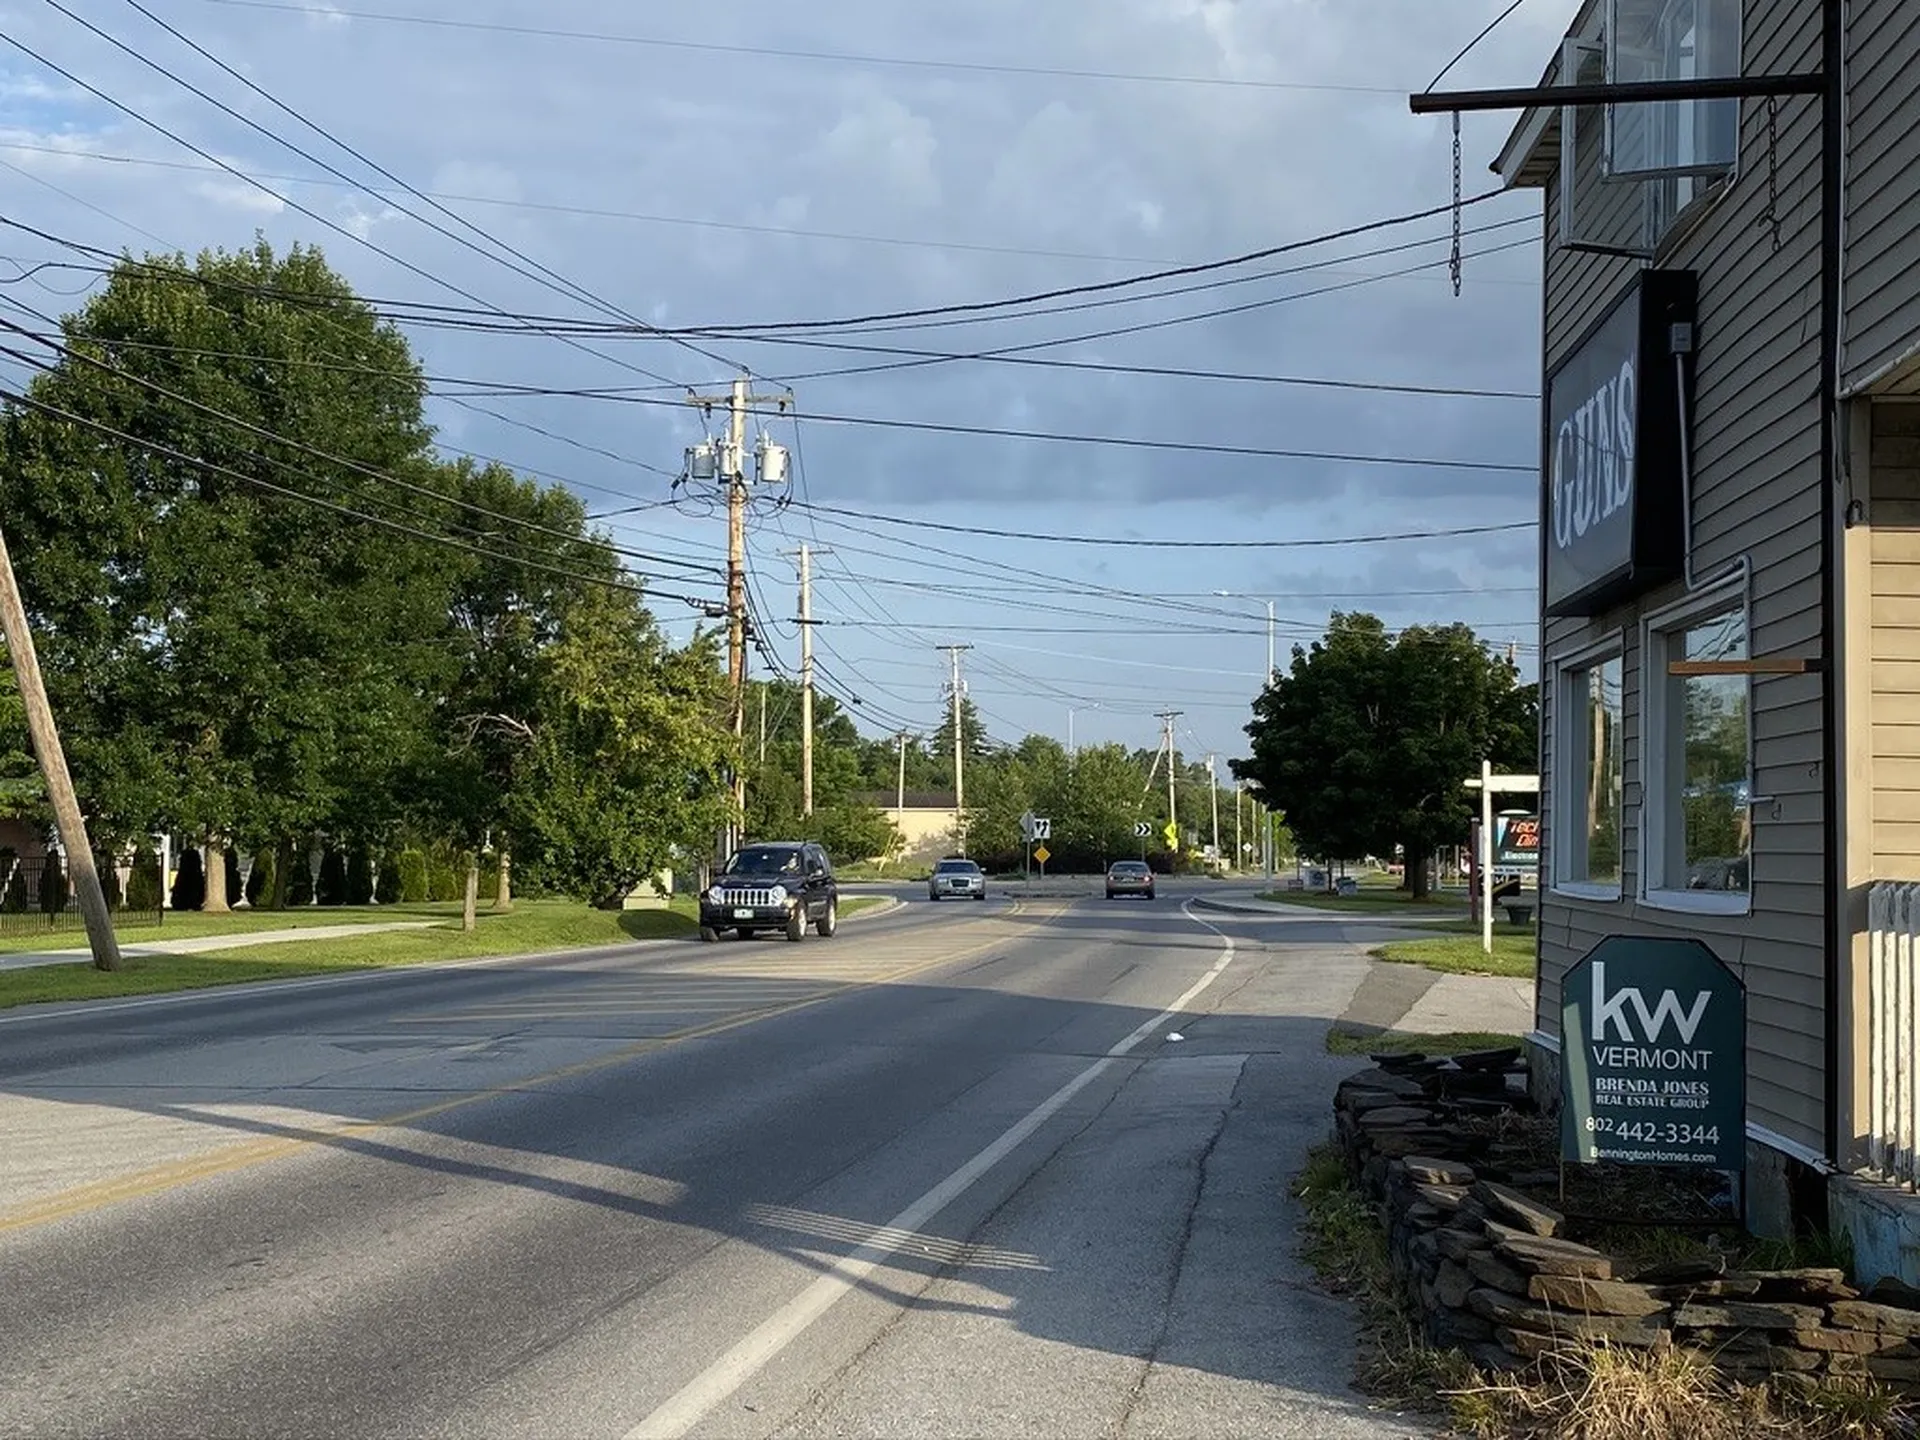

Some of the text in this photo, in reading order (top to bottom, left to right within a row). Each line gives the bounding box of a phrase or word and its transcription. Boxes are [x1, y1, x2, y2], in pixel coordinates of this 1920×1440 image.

[1554, 361, 1634, 549] GUNS
[1592, 1046, 1713, 1071] VERMONT
[1595, 1077, 1710, 1096] BRENDA JONES
[1595, 1094, 1710, 1109] REAL ESTATE GROUP
[1586, 1116, 1720, 1145] 802 442-3344
[1590, 1145, 1717, 1163] BenningtonHomes.com
